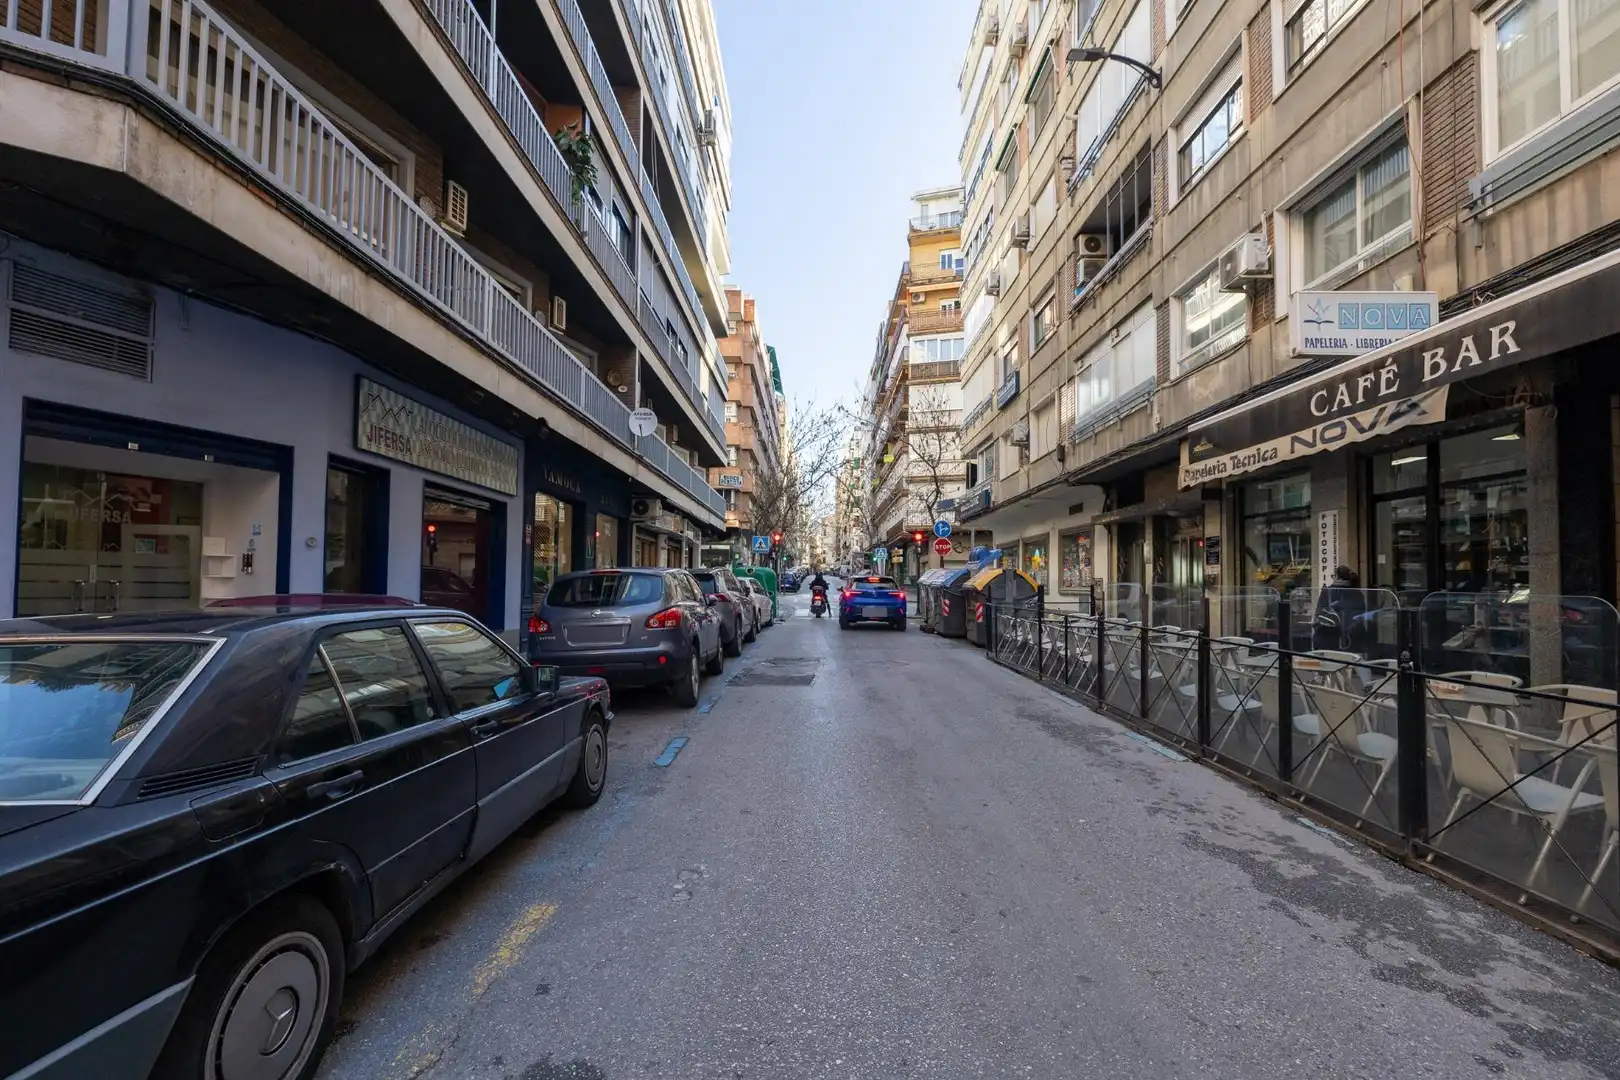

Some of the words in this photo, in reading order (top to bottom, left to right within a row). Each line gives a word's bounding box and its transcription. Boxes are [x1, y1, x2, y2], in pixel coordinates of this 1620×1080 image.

[1341, 307, 1428, 325] NOVA
[1304, 337, 1348, 349] PAPELERIA
[1309, 357, 1400, 417] CAFÉ
[1421, 319, 1521, 383] BAR
[366, 423, 412, 456] JIFERSA
